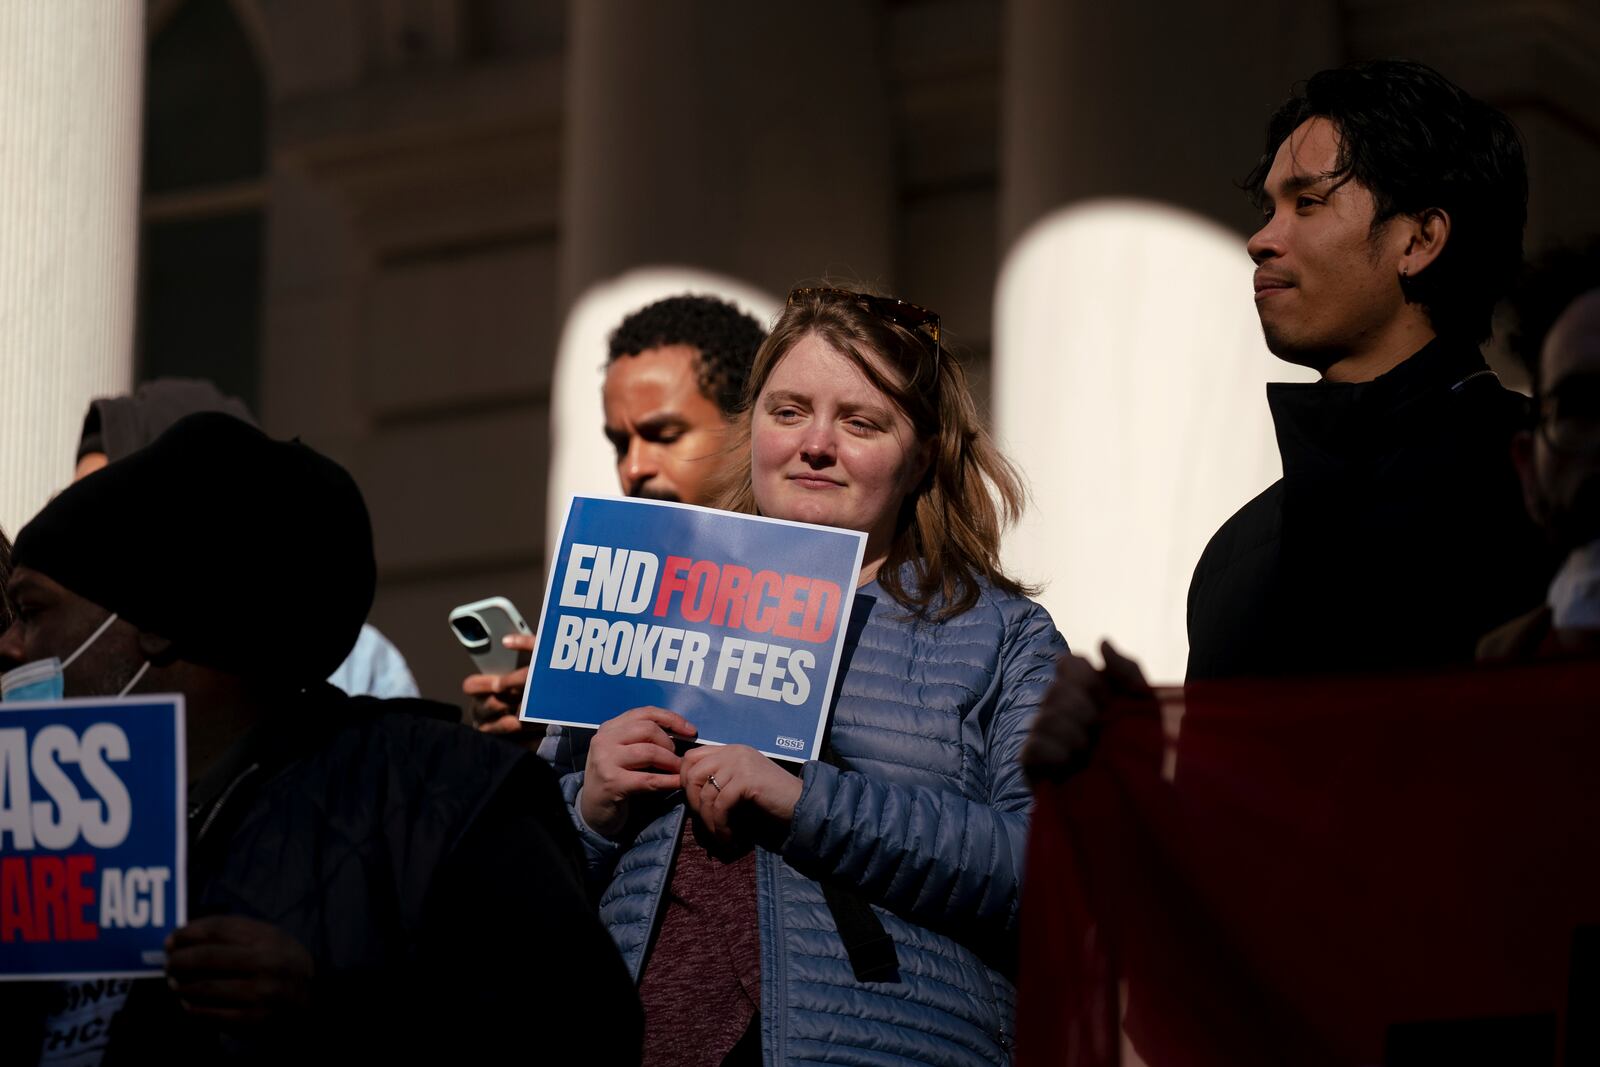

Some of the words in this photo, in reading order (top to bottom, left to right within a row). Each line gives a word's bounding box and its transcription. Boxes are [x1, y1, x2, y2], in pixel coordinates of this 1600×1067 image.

[559, 543, 659, 615] END
[653, 555, 842, 644] FORCED
[549, 614, 711, 687] BROKER
[712, 636, 816, 706] FEES
[100, 867, 169, 929] ACT
